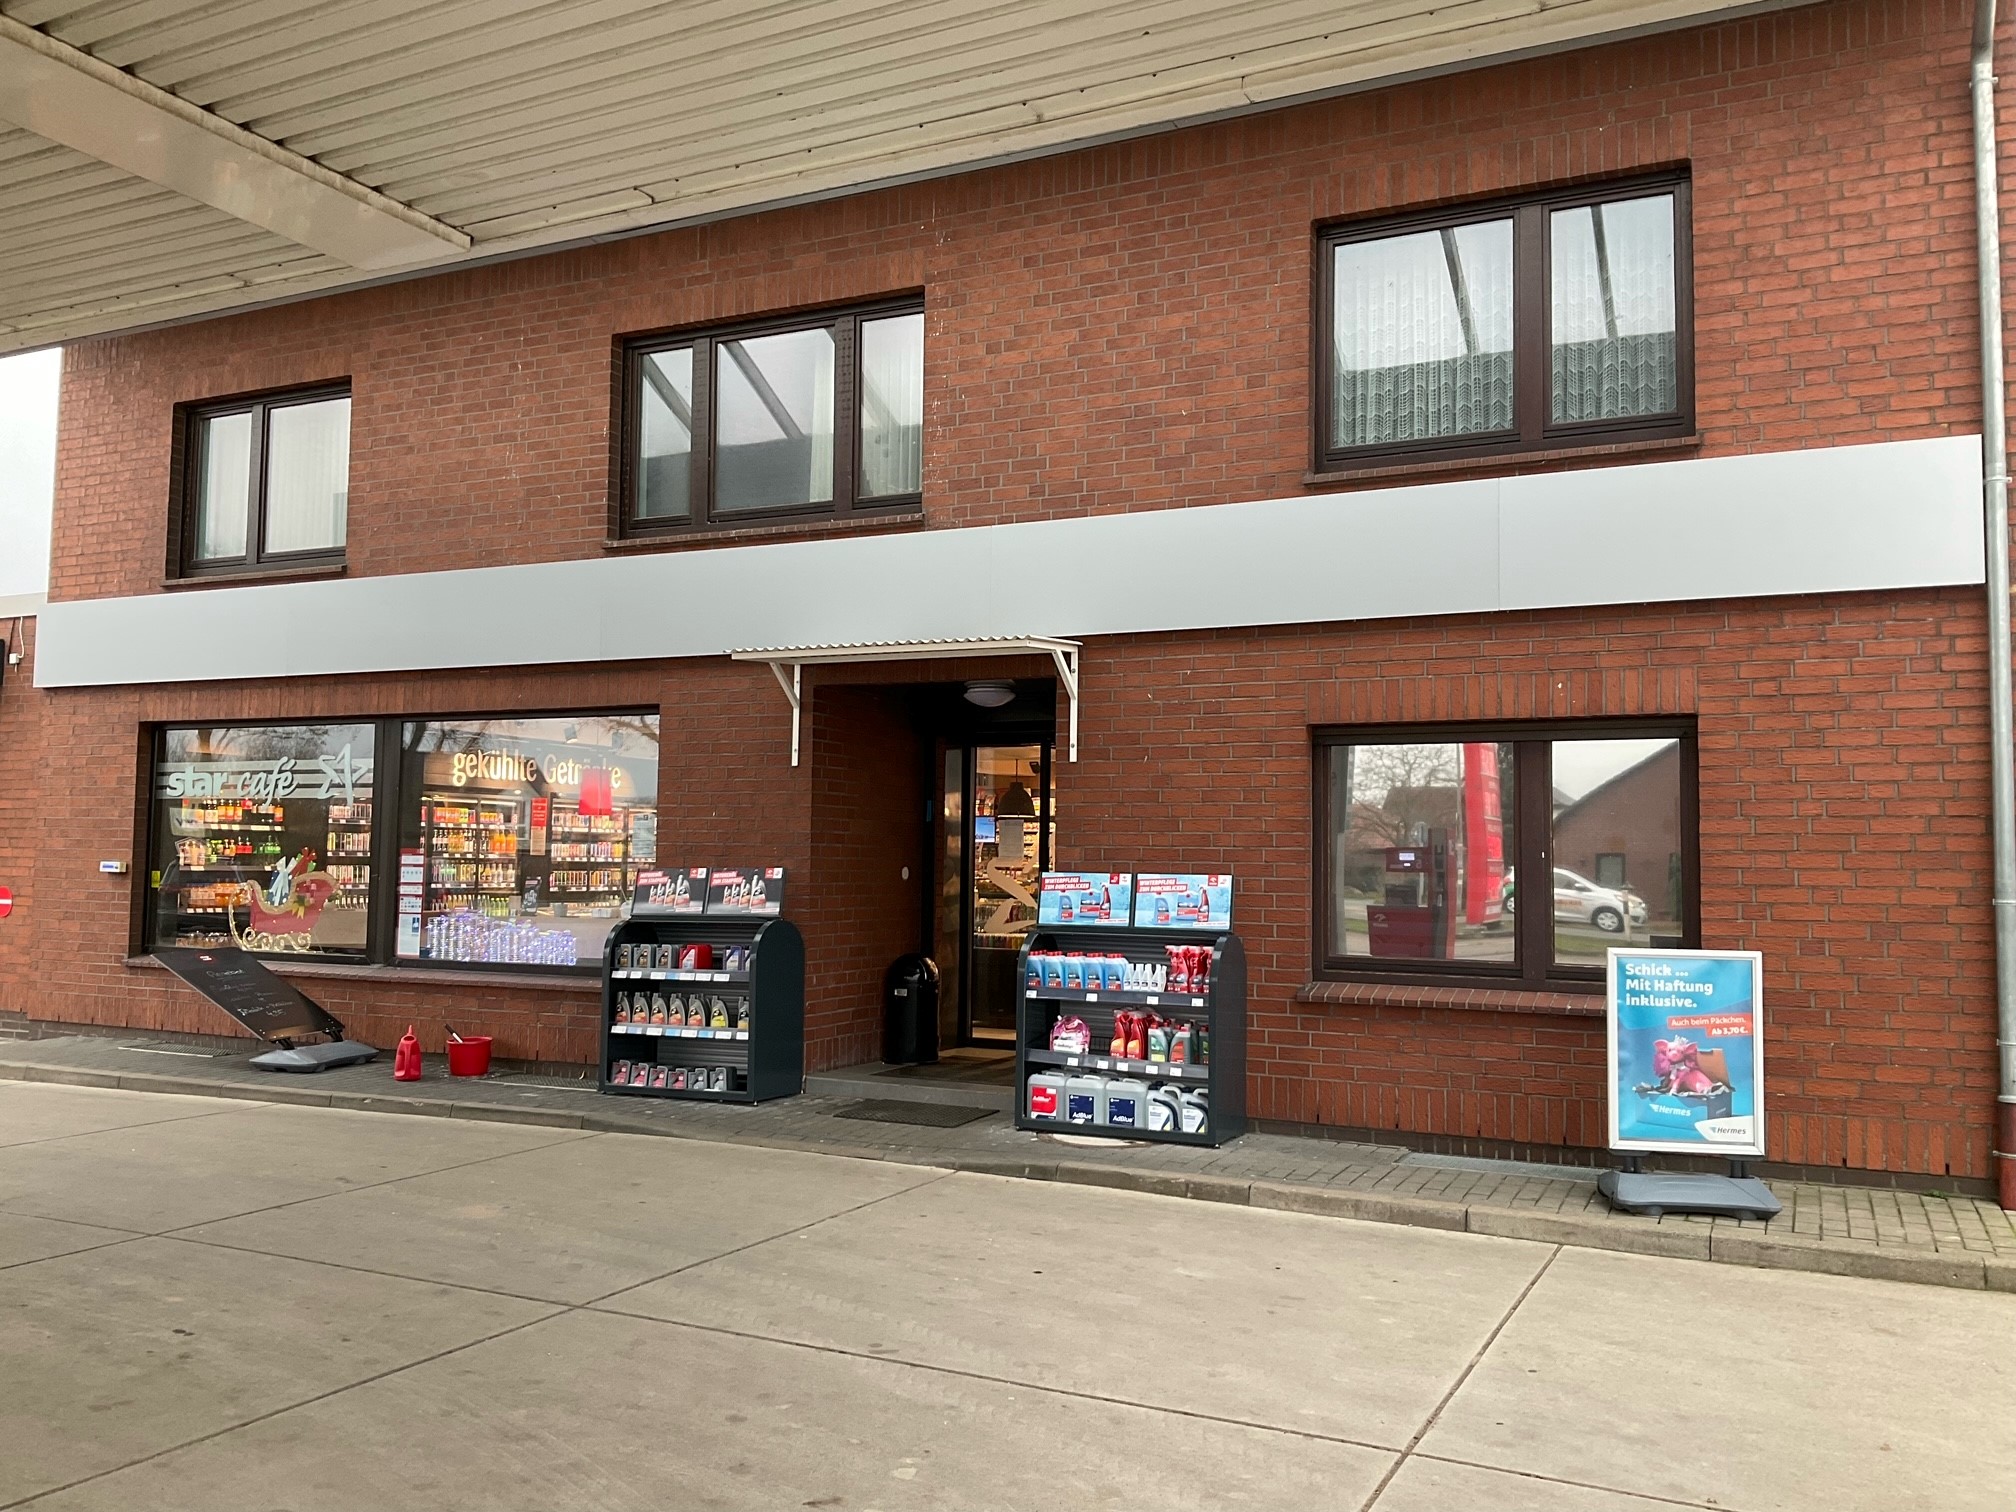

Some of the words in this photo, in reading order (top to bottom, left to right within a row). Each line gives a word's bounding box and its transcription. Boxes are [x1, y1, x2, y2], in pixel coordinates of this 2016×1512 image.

[453, 748, 537, 787] gekühlte
[166, 765, 229, 797] star
[236, 756, 299, 810] café
[1625, 963, 1672, 977] Schick
[1625, 978, 1651, 991] Mit
[1653, 979, 1713, 996] Haftung
[1626, 993, 1697, 1008] inklusive.
[1671, 1018, 1689, 1027] Auch
[1690, 1017, 1709, 1026] beim
[1710, 1015, 1746, 1025] Päckchen.
[1711, 1027, 1722, 1035] Ab
[1072, 1111, 1093, 1119] AdBlue
[1659, 1105, 1691, 1117] Hermes
[1113, 1115, 1135, 1123] AdBlue
[1716, 1127, 1746, 1135] Hermes
